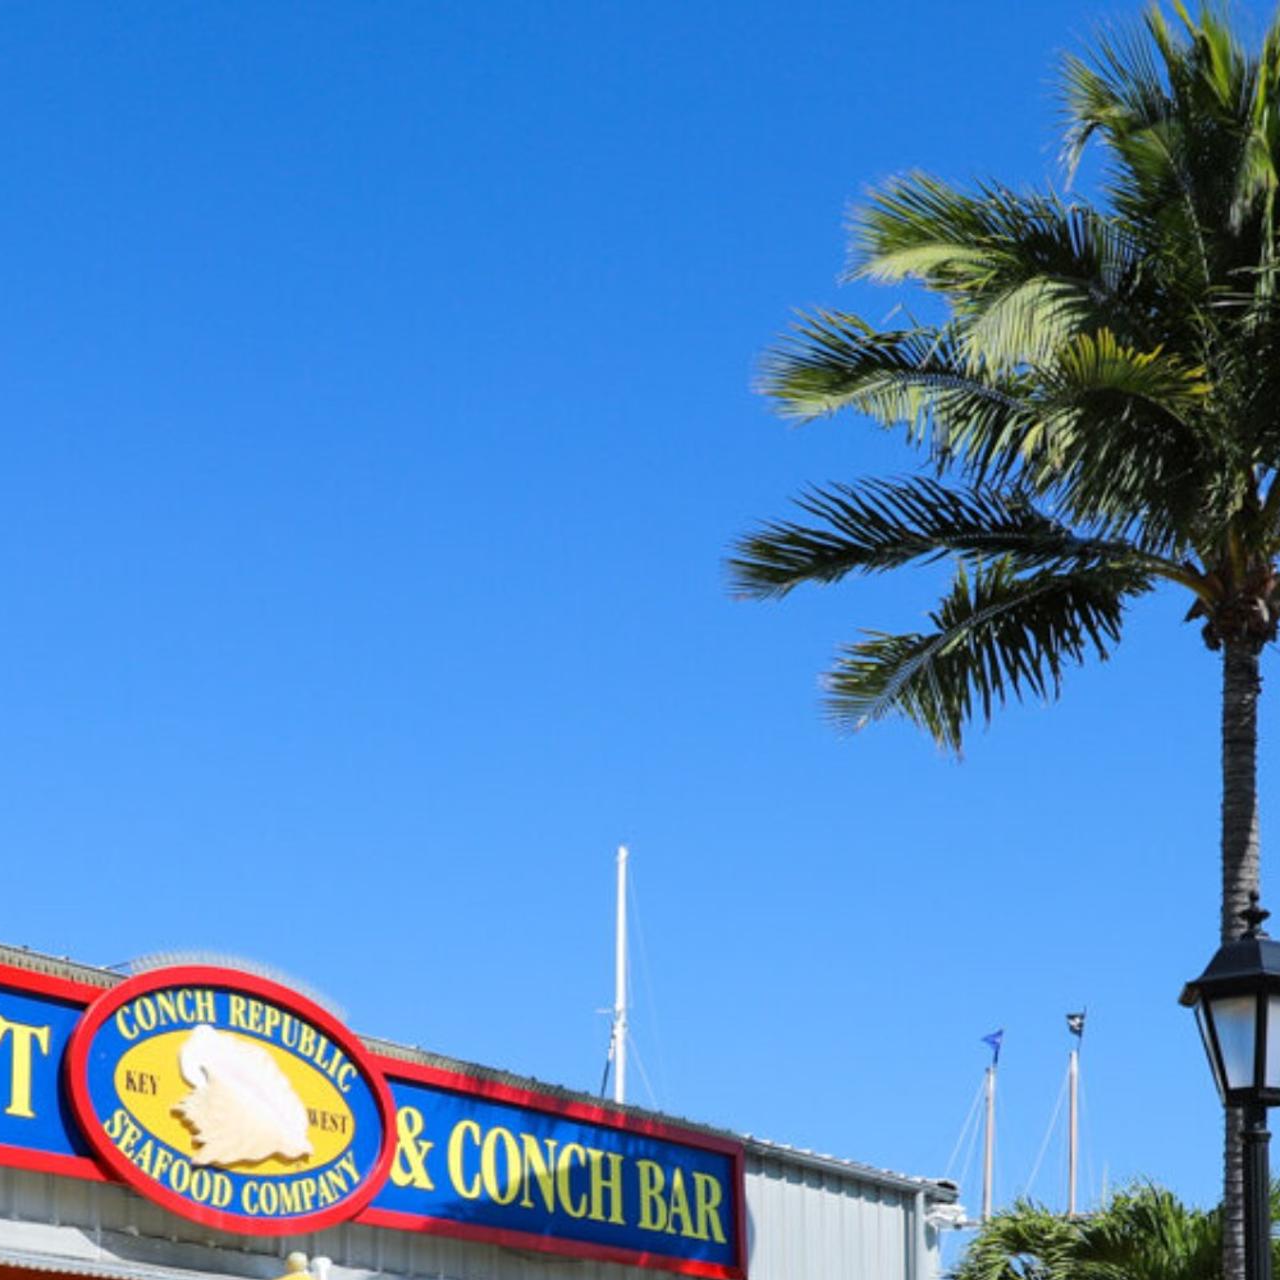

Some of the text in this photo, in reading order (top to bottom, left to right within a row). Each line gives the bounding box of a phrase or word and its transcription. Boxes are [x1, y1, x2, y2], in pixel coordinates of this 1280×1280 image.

[116, 989, 358, 1093] CONCH REPUBLIC
[125, 1069, 348, 1135] KEY WEST
[104, 1109, 361, 1216] SEAFOOD COMPANY
[390, 1106, 727, 1245] & CONCH BAR
